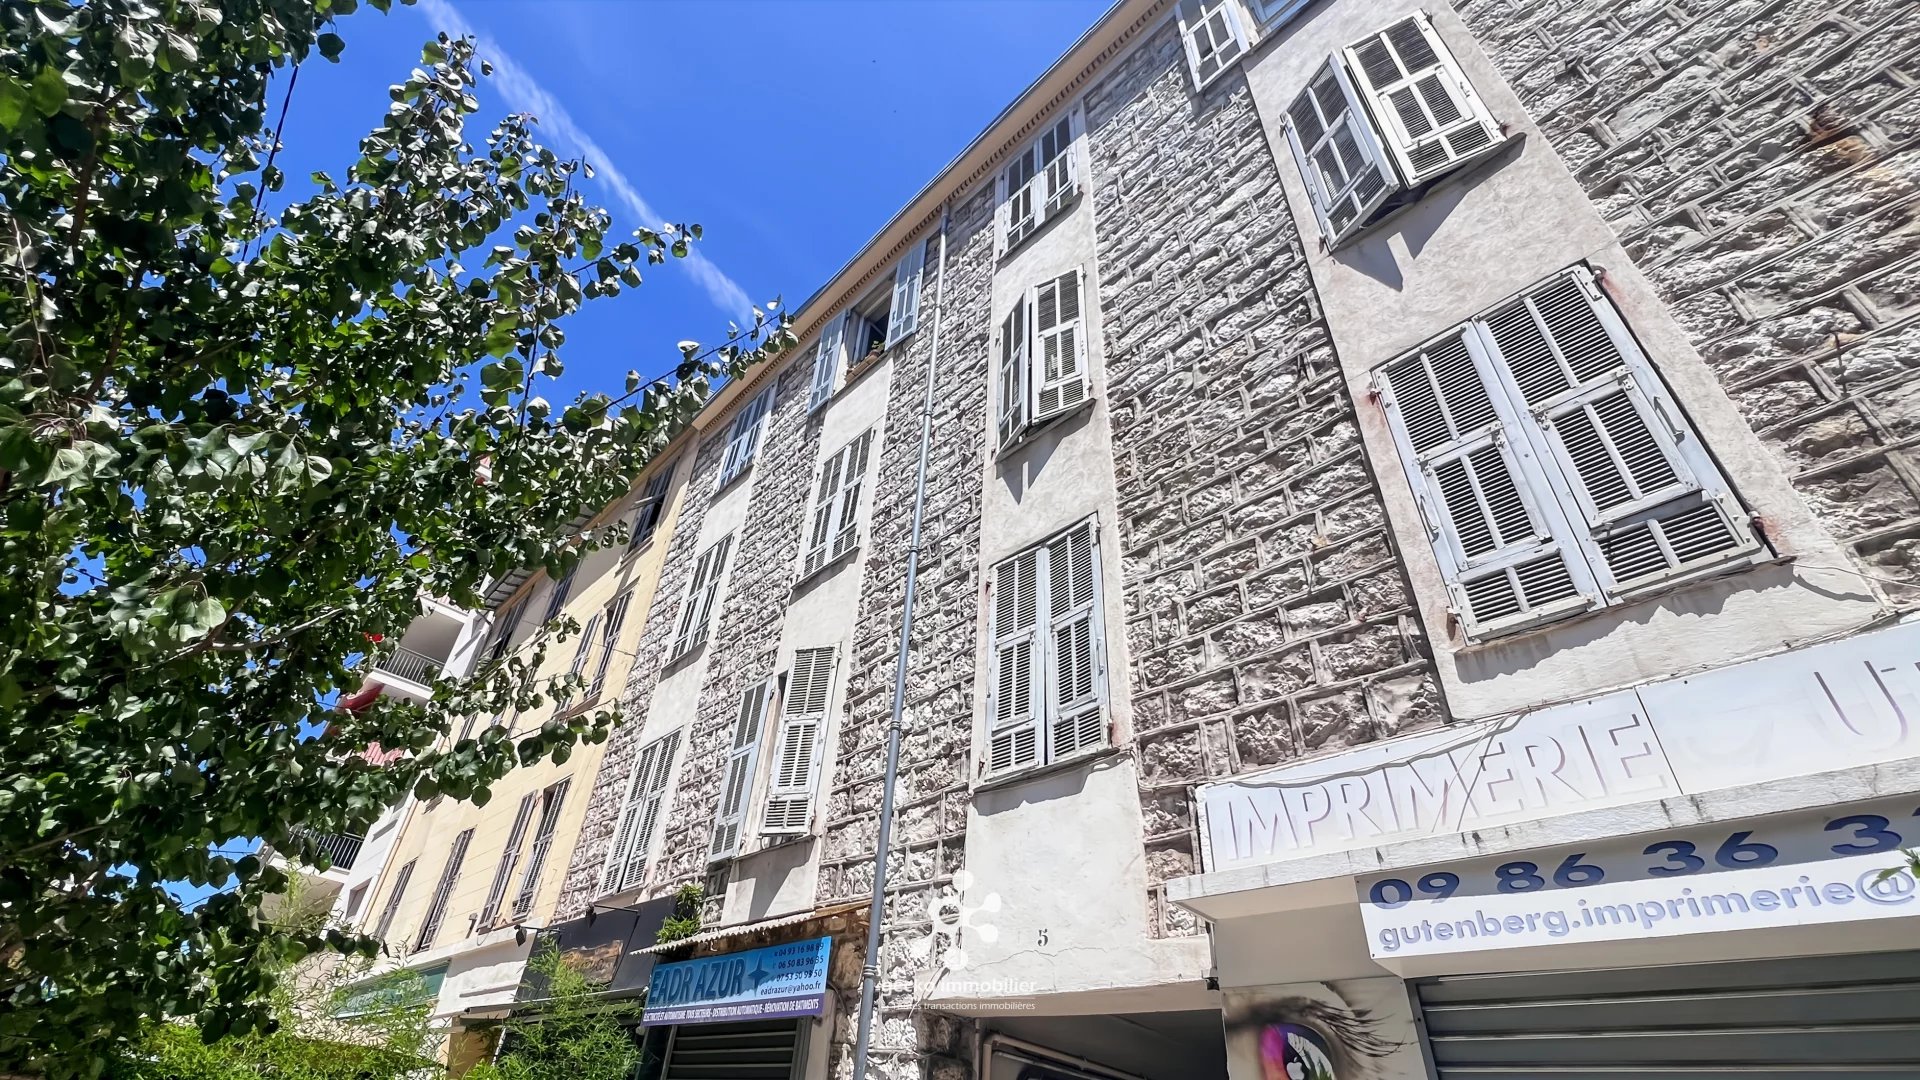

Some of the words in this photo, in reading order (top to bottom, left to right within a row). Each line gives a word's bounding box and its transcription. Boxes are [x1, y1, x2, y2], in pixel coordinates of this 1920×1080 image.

[1207, 713, 1668, 861] IMPRIMERIE
[1369, 871, 1460, 910] 09
[1495, 852, 1605, 894] 86
[1643, 831, 1779, 877] 36
[1824, 805, 1920, 856] 3
[1037, 928, 1049, 947] 5
[787, 947, 796, 956] 93
[798, 945, 805, 954] 16
[777, 960, 787, 969] 06
[787, 958, 796, 968] 50
[651, 966, 693, 1004] EADR
[695, 958, 745, 1000] AZUR
[776, 973, 785, 982] 07
[785, 972, 794, 981] 53
[813, 968, 823, 978] 50
[761, 981, 821, 995] eadrazur@yahoo.fr
